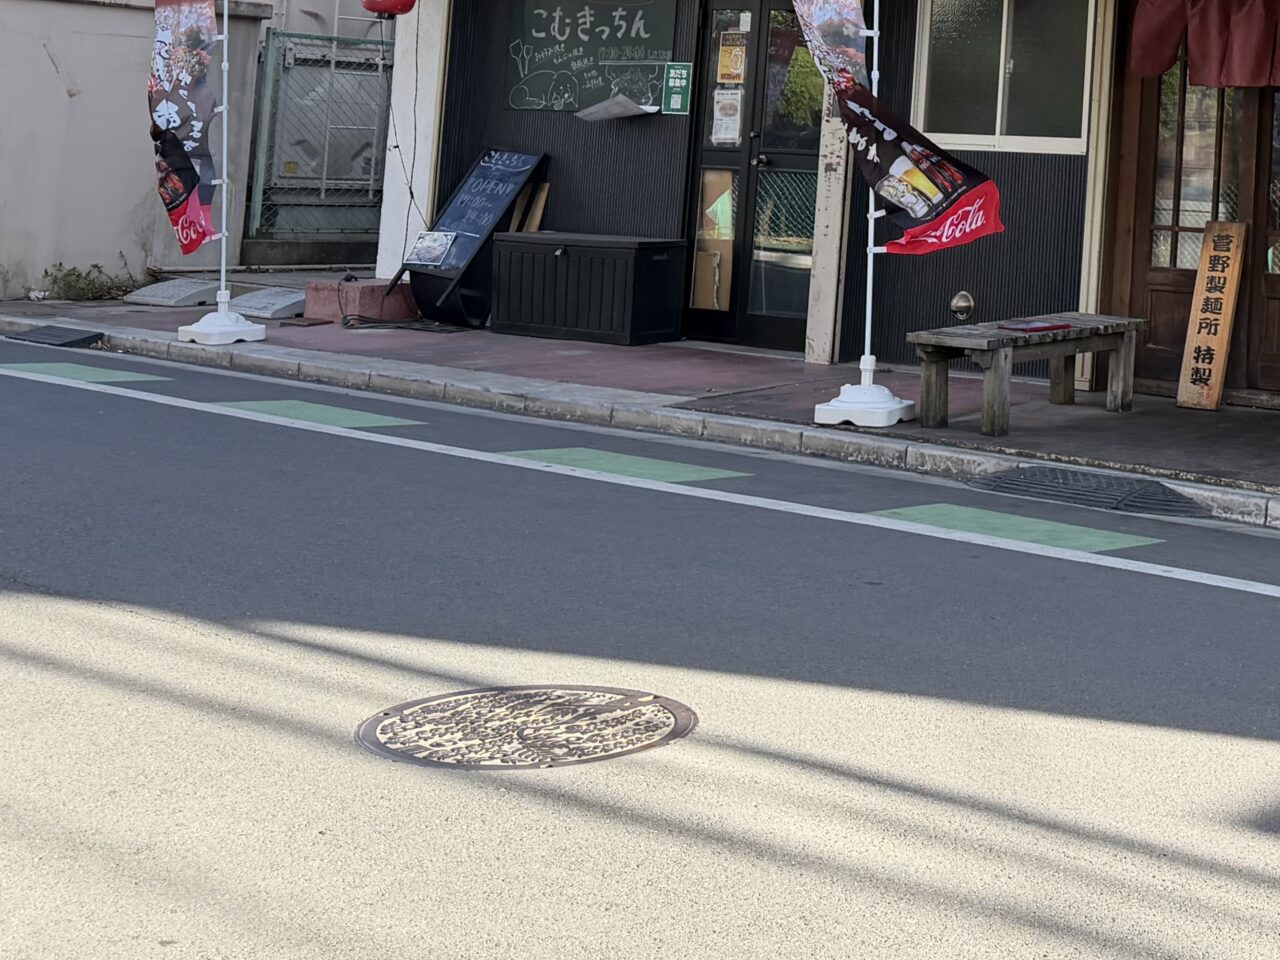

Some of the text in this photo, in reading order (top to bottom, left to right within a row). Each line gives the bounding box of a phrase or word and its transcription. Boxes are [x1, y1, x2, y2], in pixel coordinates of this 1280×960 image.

[531, 5, 651, 42] こむきっちん
